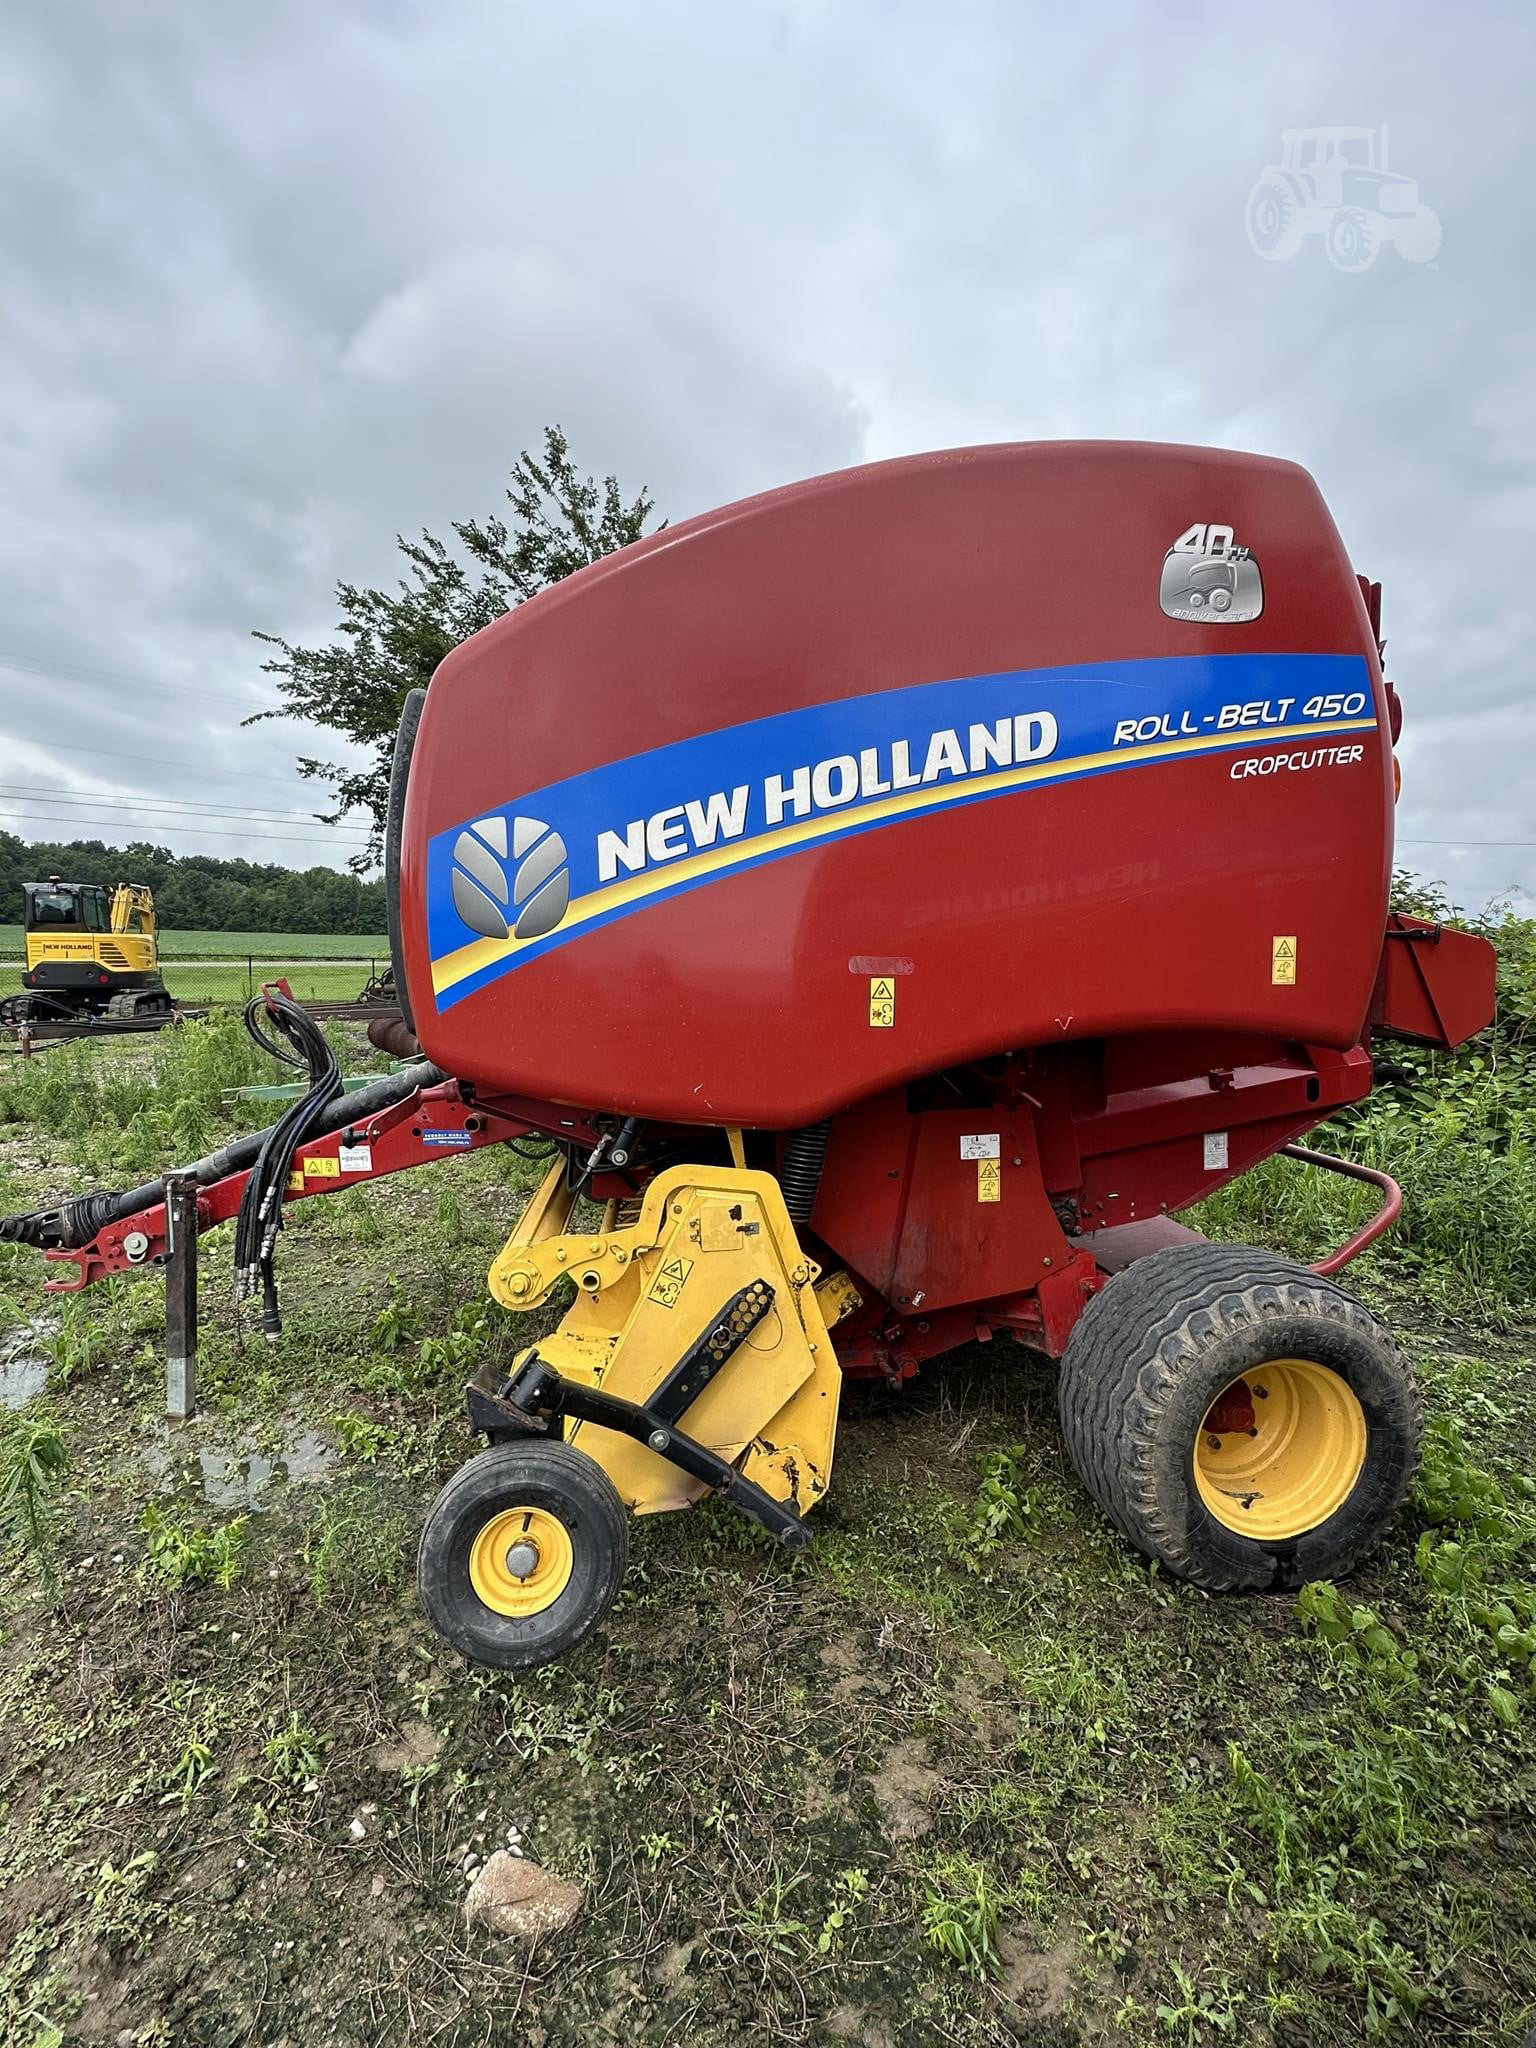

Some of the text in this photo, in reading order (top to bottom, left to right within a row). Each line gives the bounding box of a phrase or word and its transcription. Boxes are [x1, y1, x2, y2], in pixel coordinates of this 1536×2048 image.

[1112, 692, 1366, 745] ROLL-BELT 450
[1229, 745, 1364, 779] CROPCUTTER
[597, 711, 1059, 882] NEW HOLLAND
